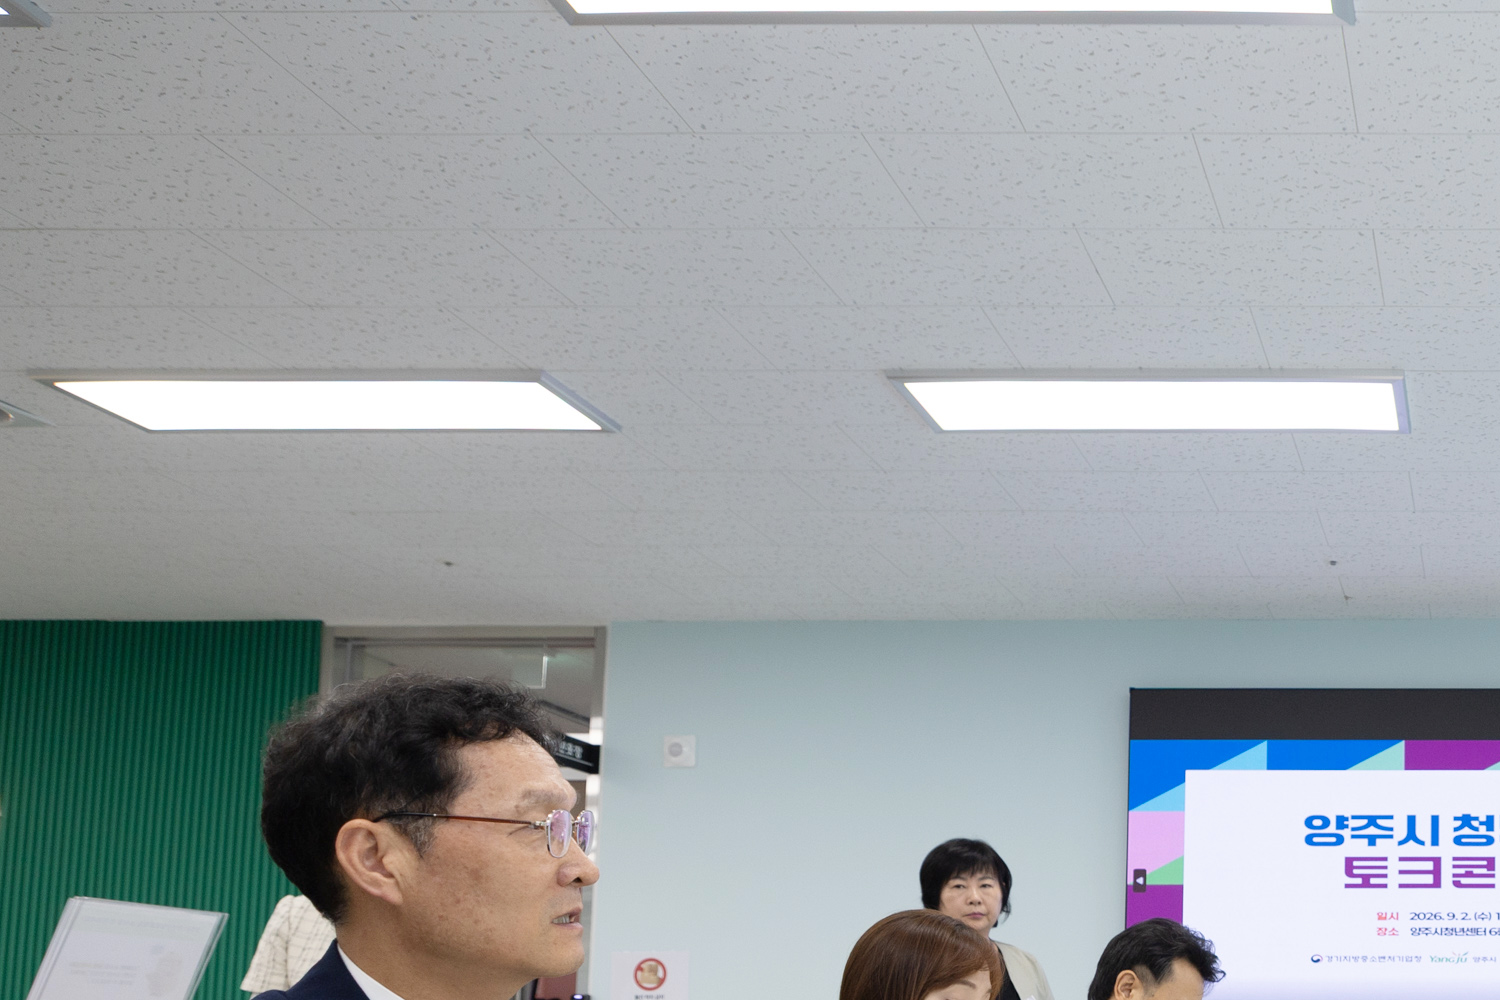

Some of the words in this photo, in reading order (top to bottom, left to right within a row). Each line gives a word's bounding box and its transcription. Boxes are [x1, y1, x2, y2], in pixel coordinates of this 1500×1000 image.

[1303, 814, 1440, 847] 양주시
[1376, 911, 1399, 921] 일시
[1409, 911, 1445, 921] 2026.
[1446, 911, 1458, 921] 9.
[1460, 911, 1472, 921] 2.
[1474, 911, 1492, 921] (수)
[1376, 927, 1399, 937] 장소
[1410, 926, 1487, 937] 양주시청년센터
